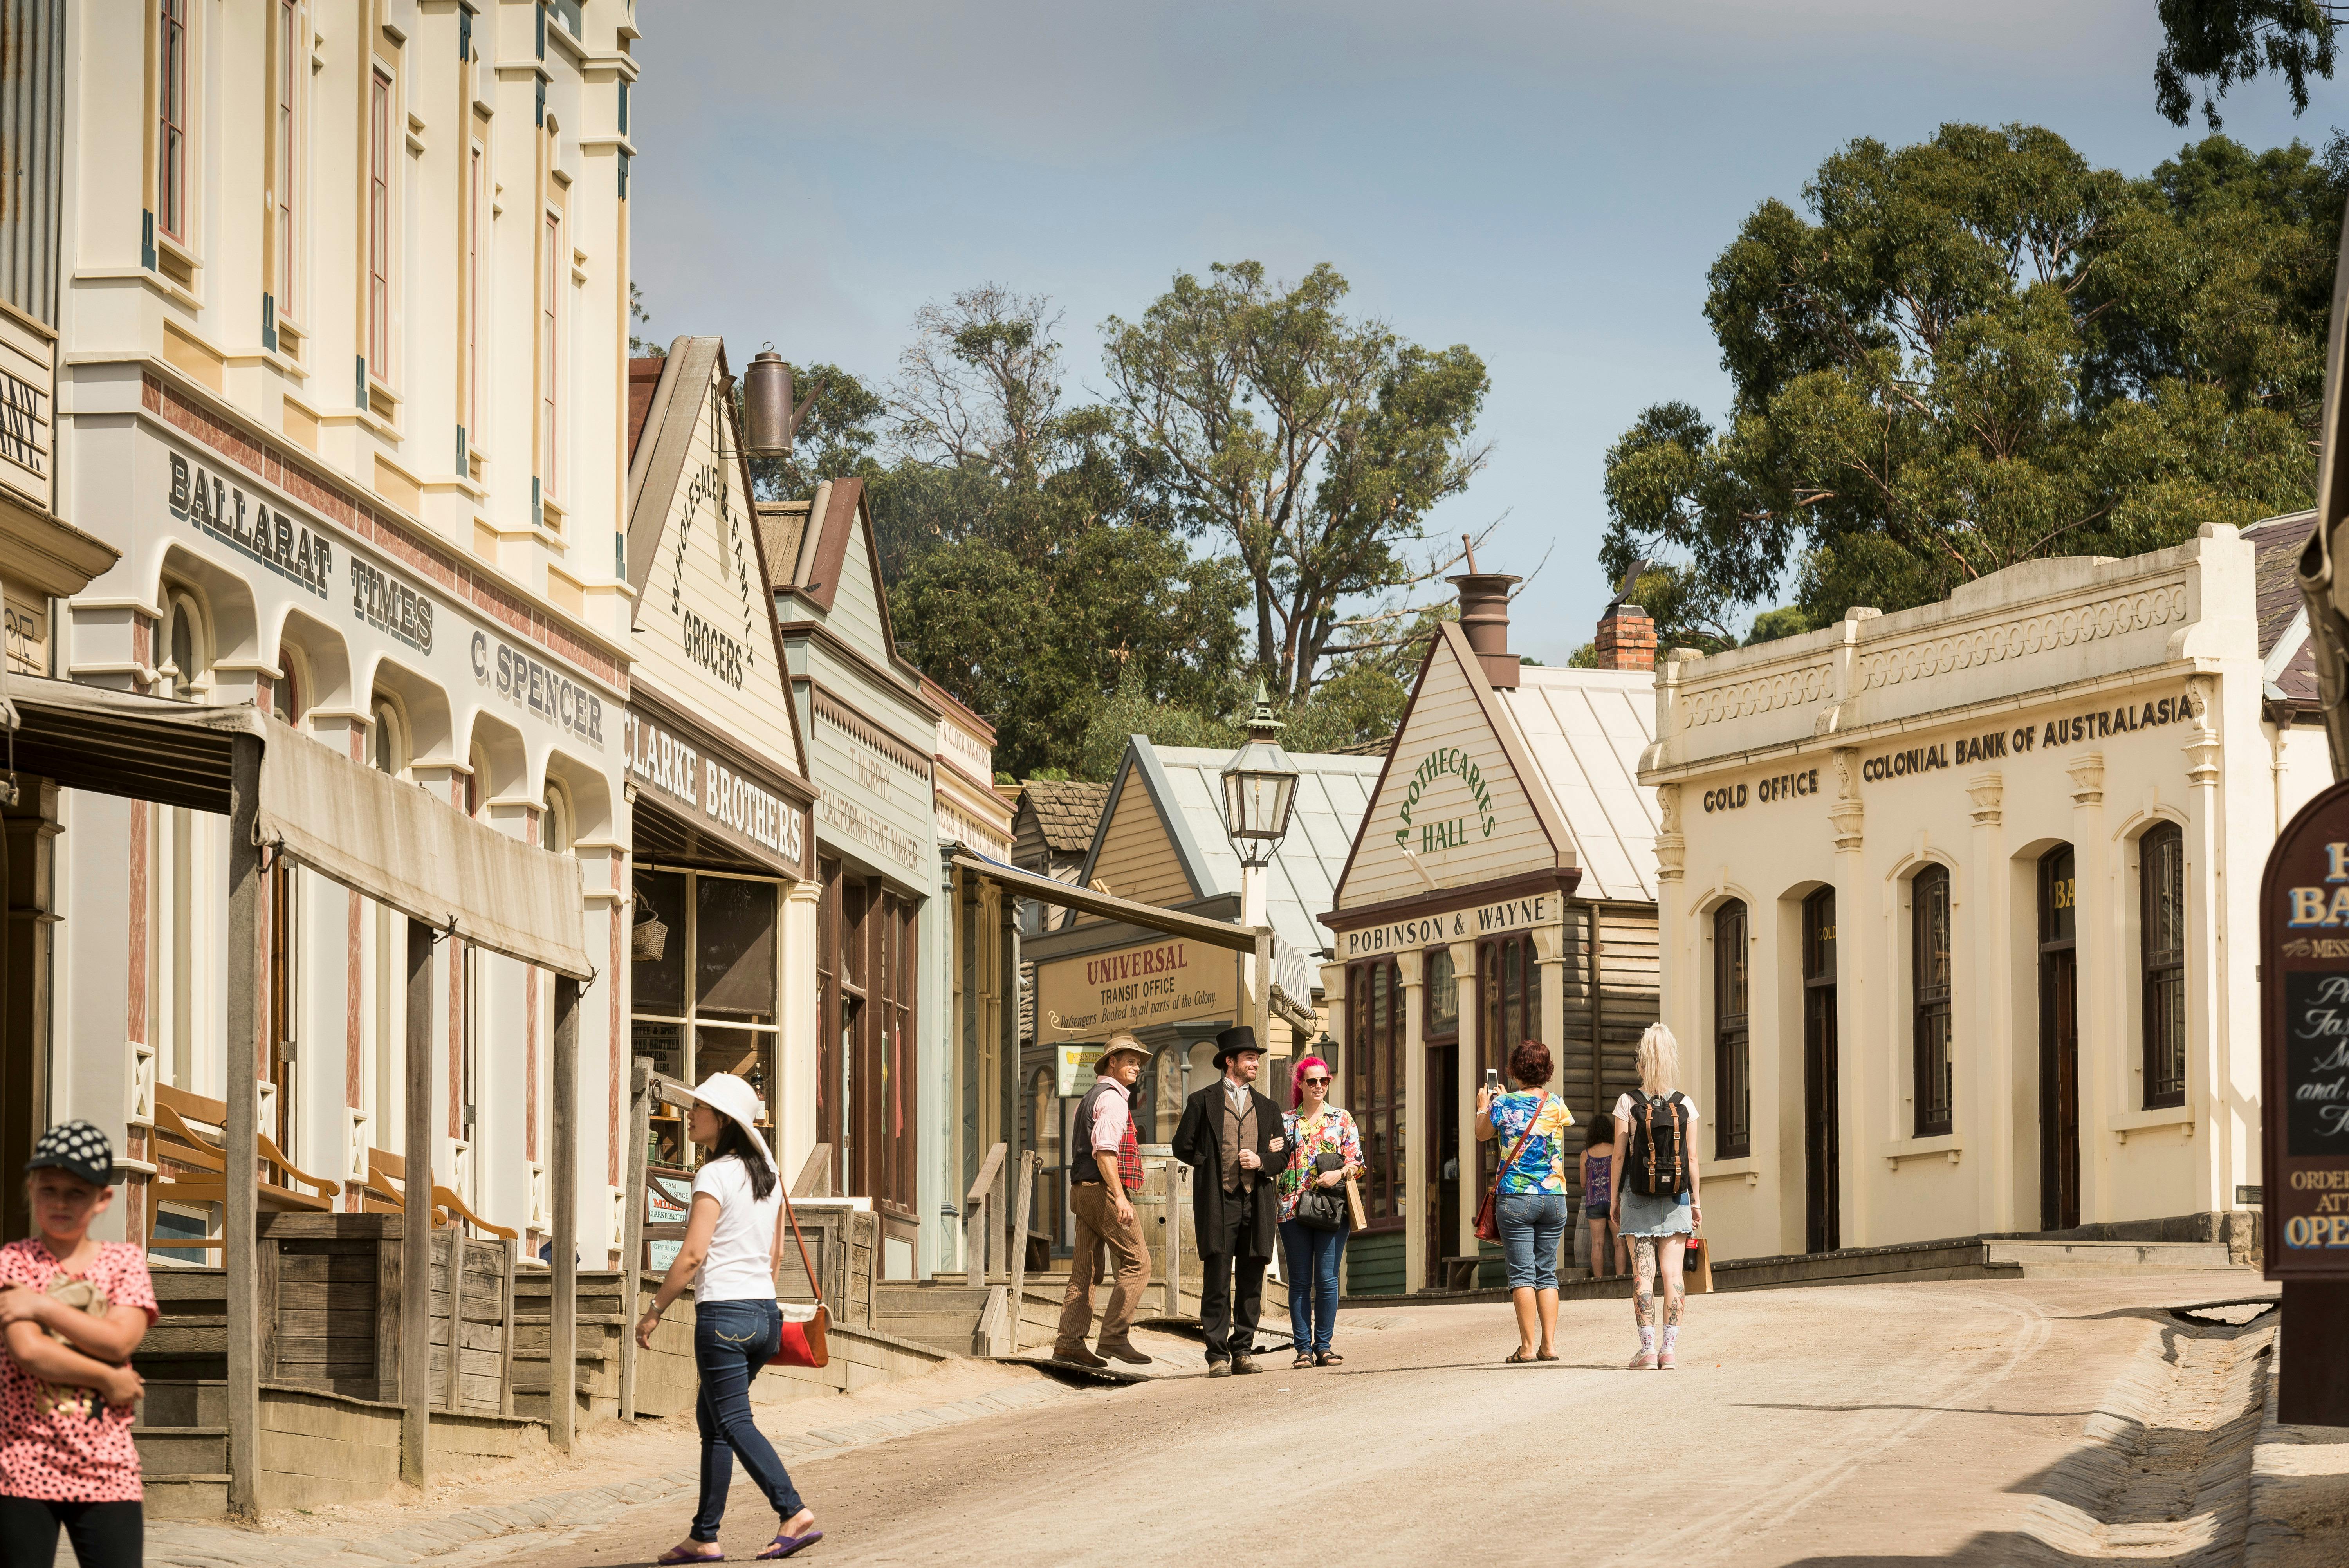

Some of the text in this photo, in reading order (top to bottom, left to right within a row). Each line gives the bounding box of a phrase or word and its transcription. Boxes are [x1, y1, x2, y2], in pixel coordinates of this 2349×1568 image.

[169, 450, 432, 655] BALLARAT TIMES
[672, 464, 754, 668] WHOLESALE & FAMILY
[684, 610, 742, 691] GROCERS
[471, 630, 604, 750] C. SPENCER
[949, 725, 965, 755] CLOCK
[967, 737, 988, 770] MAKERS
[1863, 695, 2194, 783] COLONIAL BANK OF AUSTRALASIA
[850, 747, 891, 801] T. MURPHY.
[1395, 747, 1496, 850] APOTHECARIES
[1703, 769, 1819, 813] GOLD OFFICE
[705, 758, 801, 864] BROTHERS
[823, 789, 918, 872] CALIFORNIA TENT MAKER
[1423, 818, 1469, 853] HALL
[959, 813, 964, 841] &
[966, 818, 1006, 863] BENJAMIN
[1350, 897, 1545, 955] ROBINSON & WAYNE
[1087, 943, 1187, 985] UNIVERSAL
[1101, 976, 1175, 1005] TRANSIT OFFICE
[1101, 1005, 1126, 1023] Booked
[1130, 1005, 1137, 1017] to
[1139, 1001, 1148, 1016] all
[1150, 999, 1169, 1018] parts
[1173, 995, 1180, 1010] of
[1182, 992, 1192, 1008] the
[653, 1026, 658, 1035] &
[660, 1027, 678, 1035] SPICE
[649, 1210, 667, 1219] CLARKE
[674, 1191, 689, 1200] SPICE
